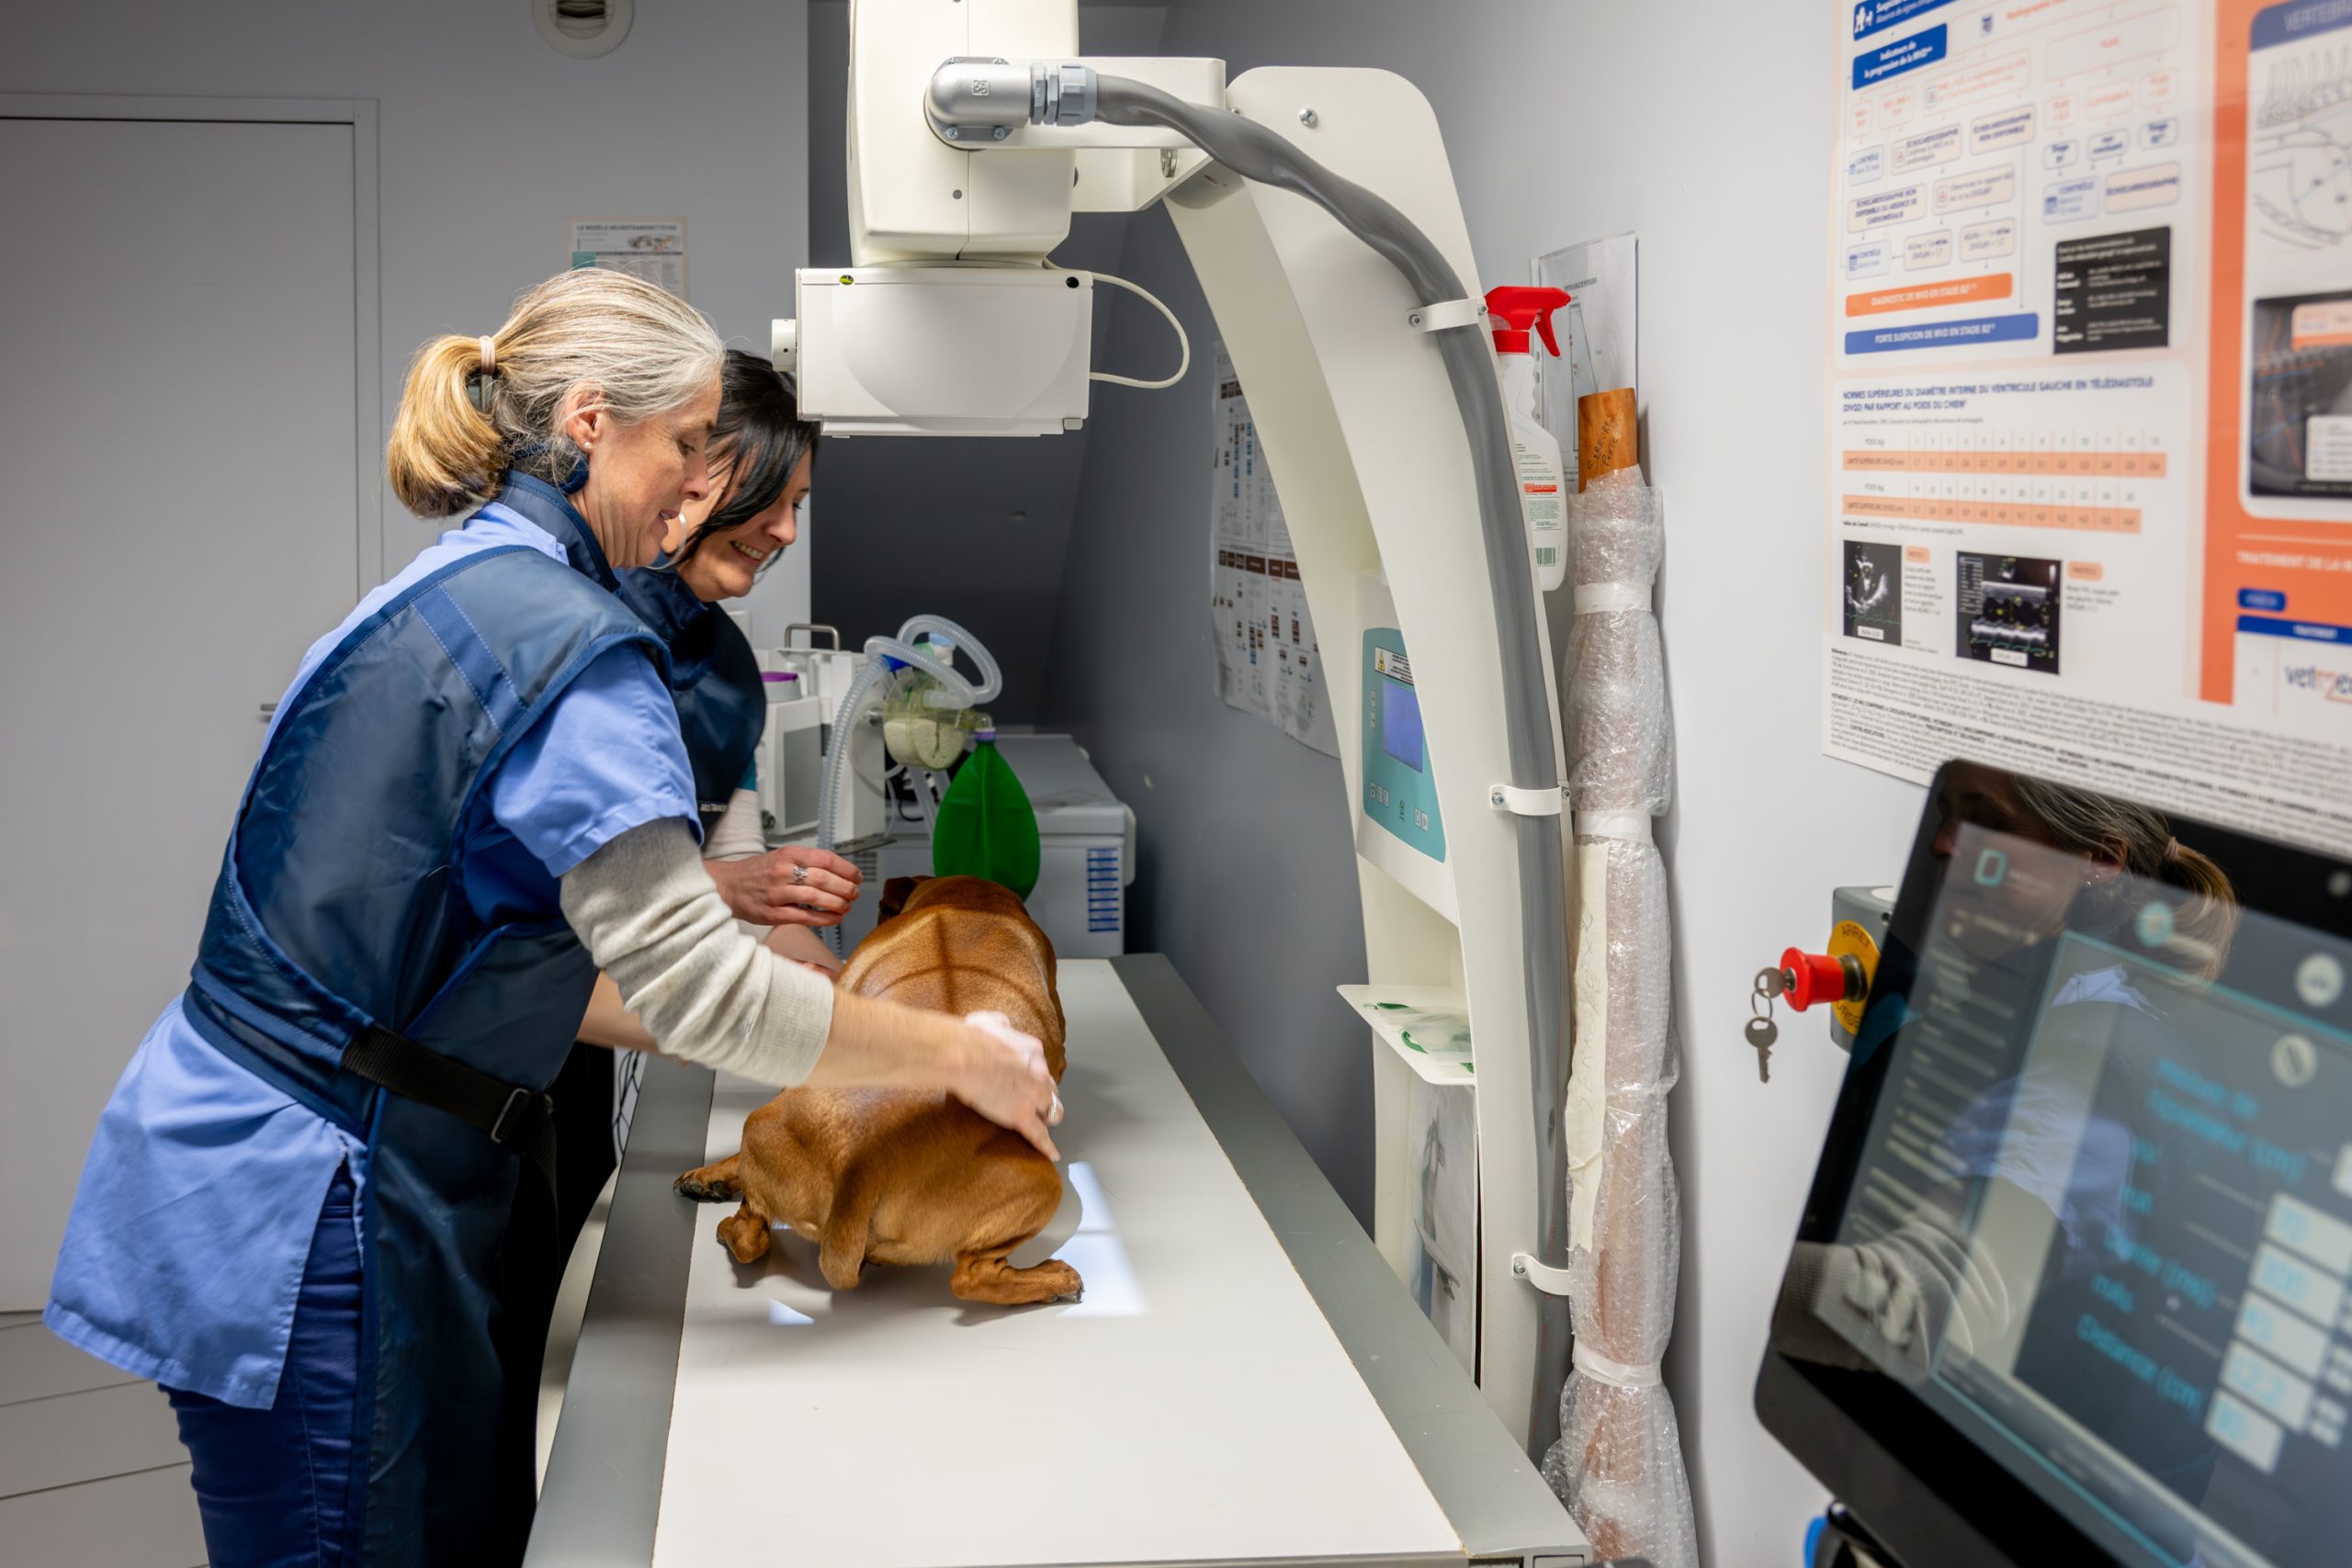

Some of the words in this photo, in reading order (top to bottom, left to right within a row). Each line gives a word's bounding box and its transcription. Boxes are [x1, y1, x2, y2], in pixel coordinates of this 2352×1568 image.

[1875, 333, 1893, 344] FORTE
[1843, 389, 1866, 400] NORMES
[1867, 388, 1904, 399] SUPÉRIEURES
[1905, 389, 1914, 397] DU
[1916, 386, 1946, 397] DIAMÈTRE
[1949, 385, 1976, 395] INTERNE
[1979, 384, 1989, 394] DU
[1992, 381, 2036, 393] VENTRICULE
[2039, 379, 2072, 391] GAUCHE
[2075, 379, 2086, 390] EN
[1864, 403, 1874, 412] PAR
[1875, 401, 1902, 412] RAPPORT
[1914, 400, 1930, 411] POIDS
[1933, 400, 1941, 410] DU
